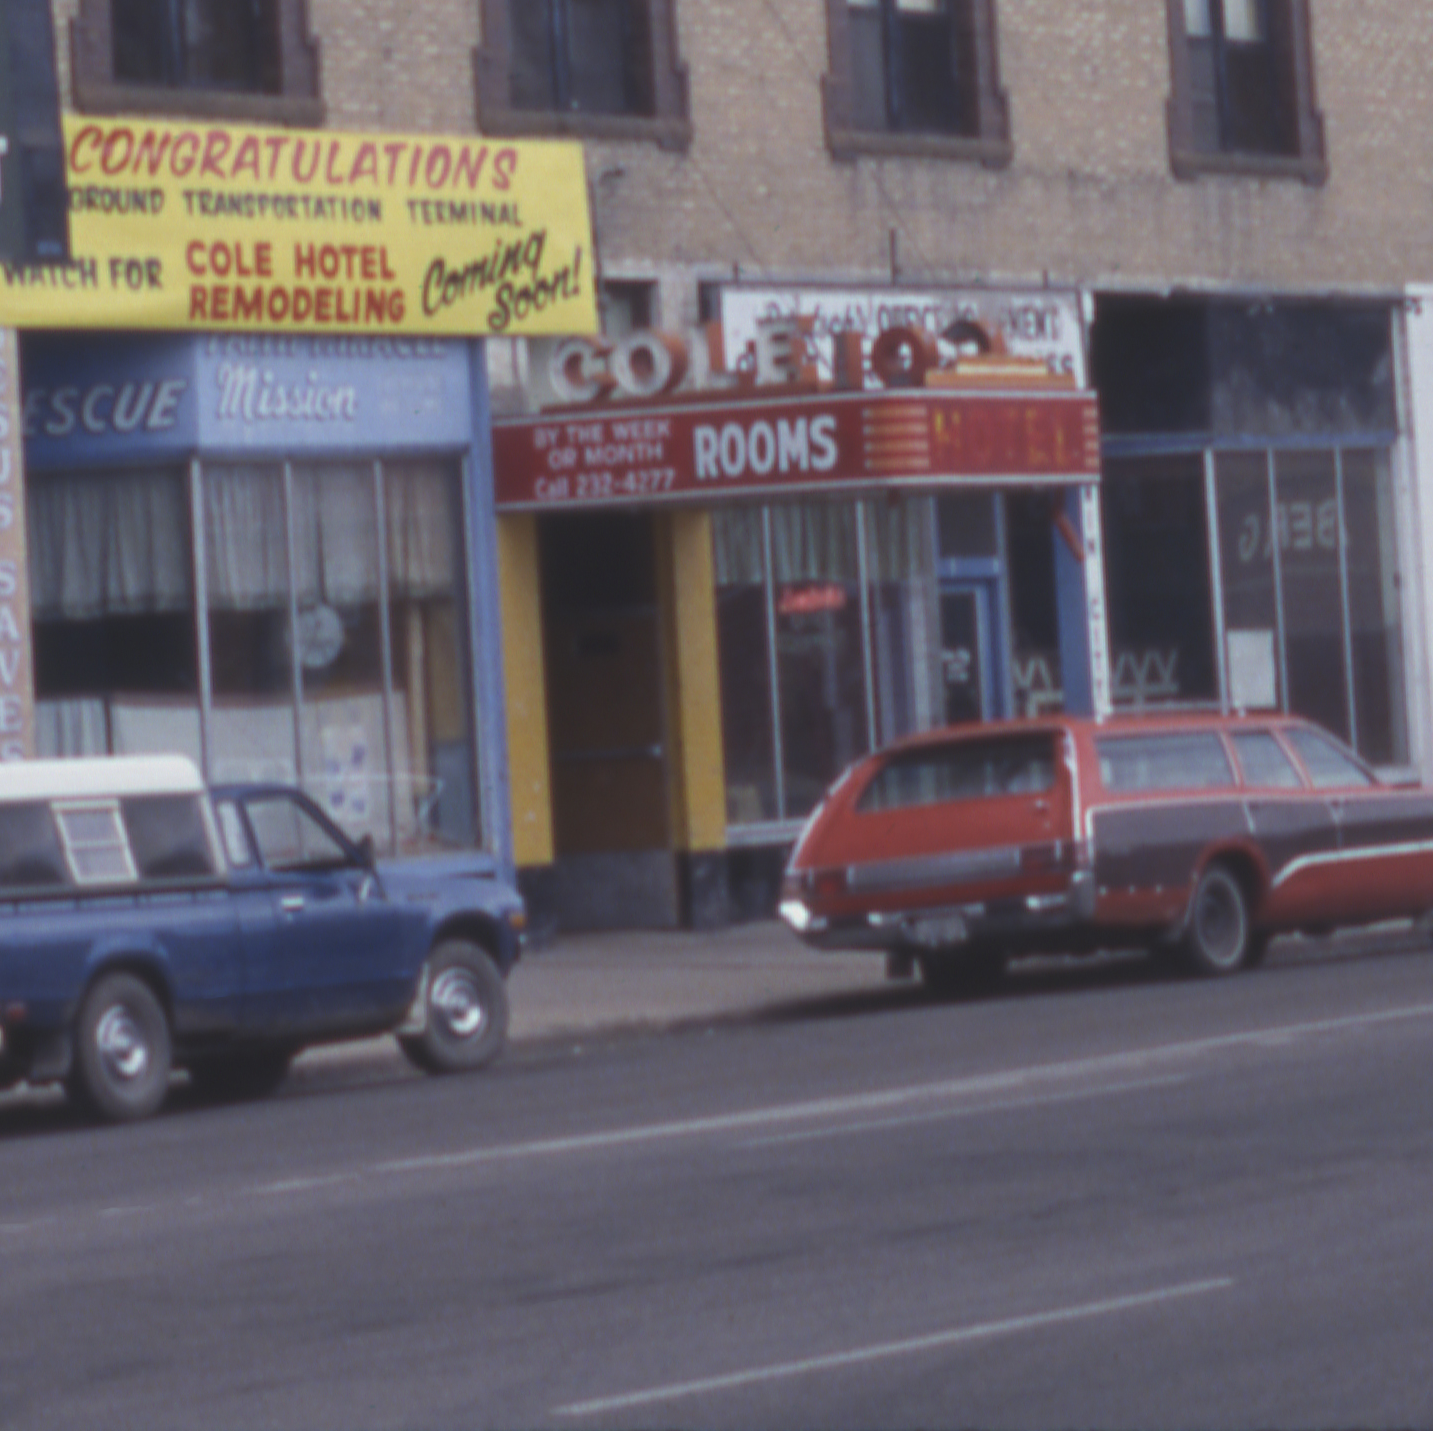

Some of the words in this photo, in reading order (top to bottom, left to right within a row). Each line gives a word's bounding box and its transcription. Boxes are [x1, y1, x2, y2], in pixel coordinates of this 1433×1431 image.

[69, 124, 519, 192] CONGRATULATIONS
[183, 188, 384, 224] TRANSPORTATION
[406, 196, 524, 228] TERMINAL
[109, 257, 163, 290] FOR
[185, 239, 275, 281] COLE
[294, 241, 397, 282] HOTEL
[420, 226, 548, 319] Coming
[487, 245, 584, 332] Soon!
[188, 283, 407, 326] REMODELING
[24, 377, 188, 437] ESCUE
[216, 362, 357, 423] Mission
[533, 426, 558, 448] BY
[566, 421, 603, 445] THE
[611, 418, 672, 440] WEEK
[547, 447, 577, 470] OR
[585, 441, 664, 466] MONTH
[693, 413, 839, 481] ROOMS
[534, 476, 571, 501] Call
